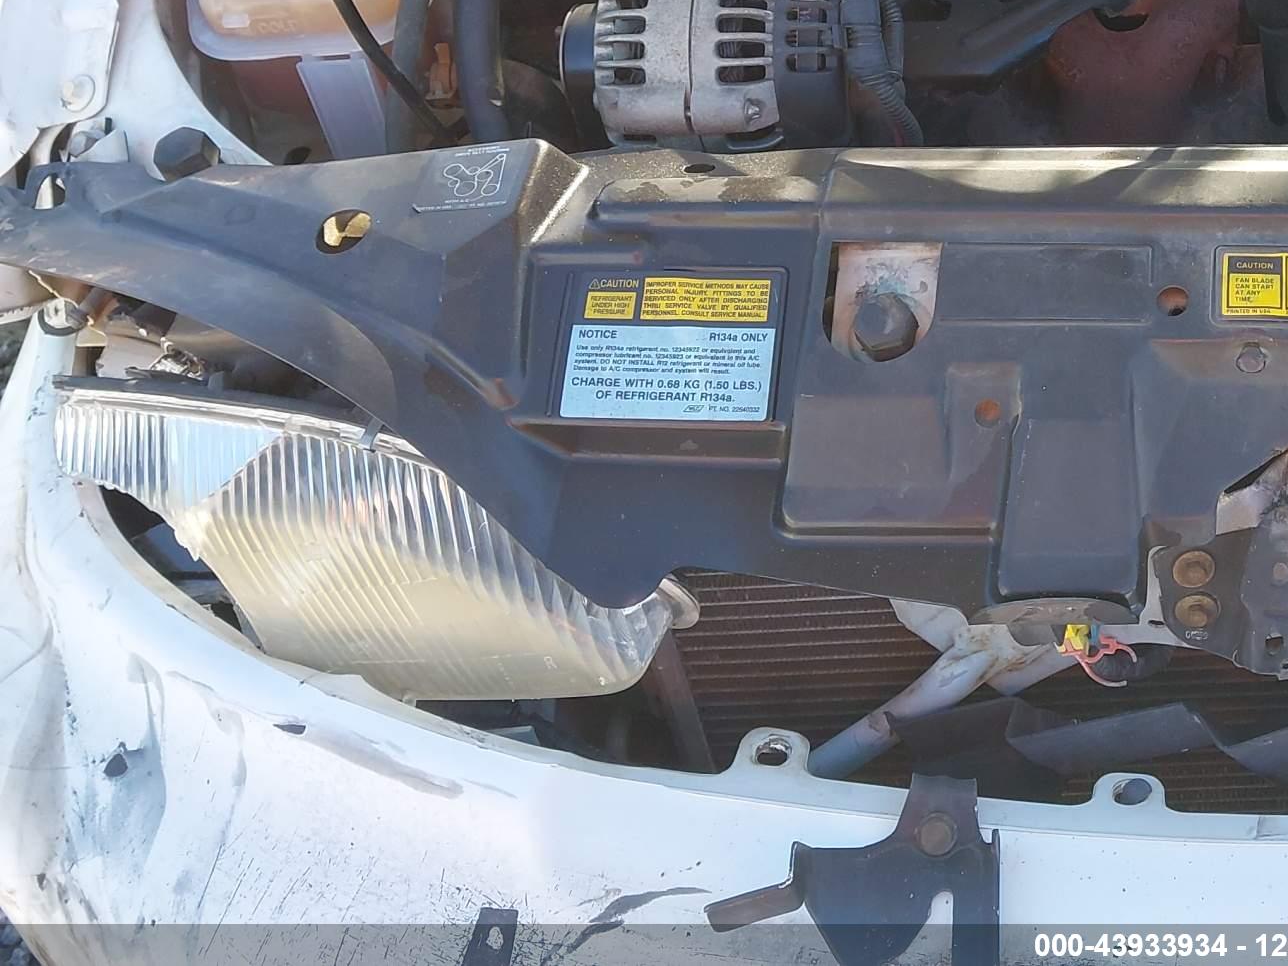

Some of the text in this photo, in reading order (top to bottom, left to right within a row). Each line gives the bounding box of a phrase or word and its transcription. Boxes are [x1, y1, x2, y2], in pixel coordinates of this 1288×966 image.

[600, 279, 639, 288] CAUTION
[678, 281, 704, 289] SERVICE
[579, 330, 618, 339] NOTICE
[710, 332, 768, 343] R134a ONLY
[591, 345, 604, 353] only
[626, 345, 658, 353] refrigerant
[710, 347, 742, 355] equivalent
[694, 353, 726, 361] equivalent
[574, 365, 599, 373] Damage
[572, 376, 762, 393] CHARGE WITH 0.68 KG (1.50 LBS.)
[596, 390, 736, 403] OF REFRIGERANT R134a.
